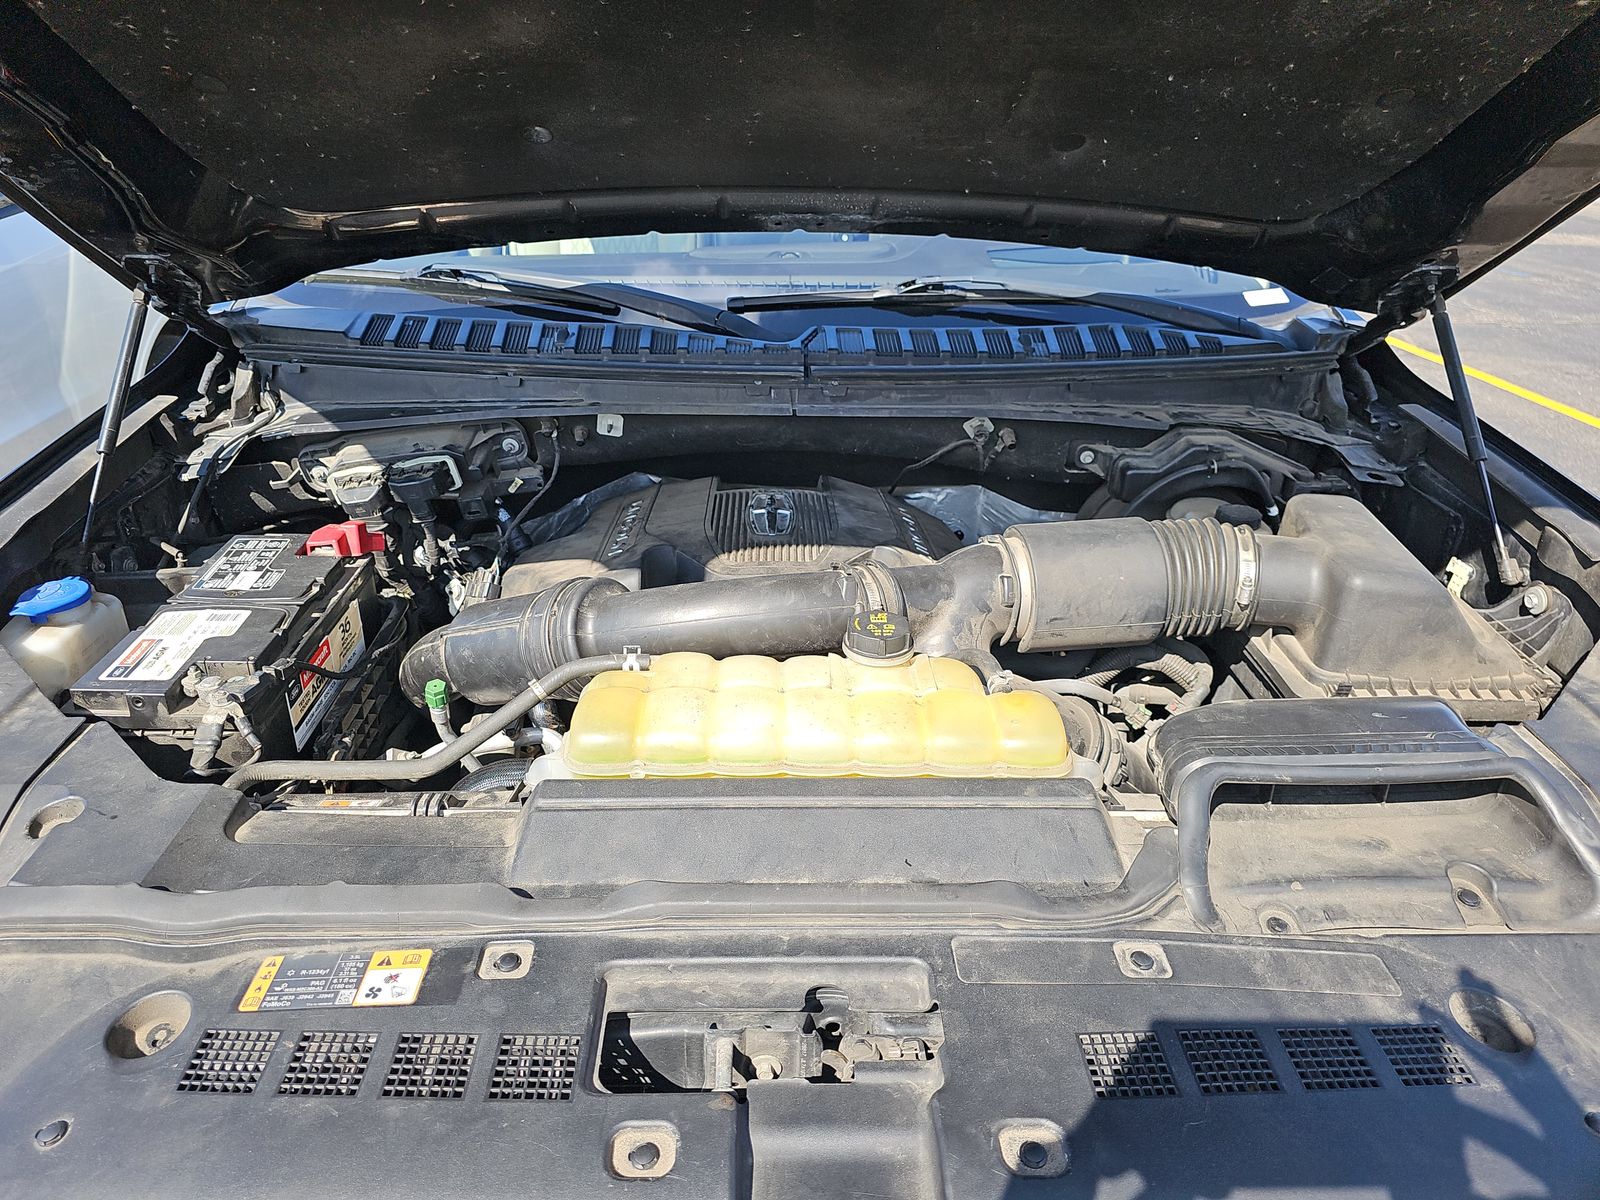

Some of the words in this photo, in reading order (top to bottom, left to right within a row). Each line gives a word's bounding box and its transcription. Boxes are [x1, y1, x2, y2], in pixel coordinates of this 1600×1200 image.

[339, 616, 351, 642] 36
[302, 645, 328, 684] Mocraft
[300, 968, 330, 976] R-1234yf
[261, 1000, 291, 1008] FoMoCo
